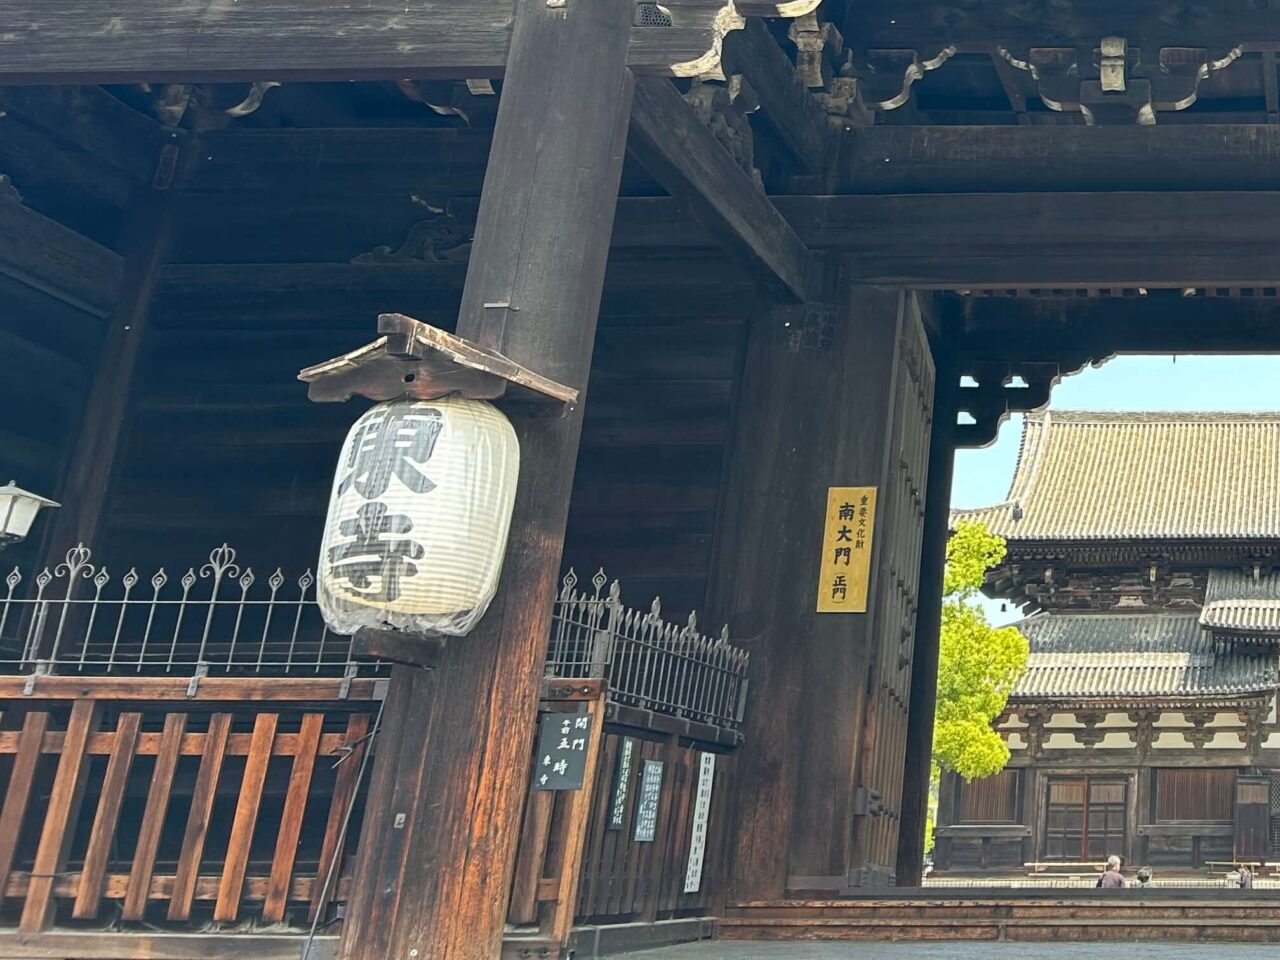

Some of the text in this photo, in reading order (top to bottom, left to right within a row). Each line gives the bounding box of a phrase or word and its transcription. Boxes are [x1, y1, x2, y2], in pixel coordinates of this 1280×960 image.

[328, 401, 443, 604] 東寺
[855, 494, 869, 550] 重要文化財
[552, 719, 572, 776] 午前五時
[572, 717, 588, 751] 開門
[539, 754, 551, 786] 東寺
